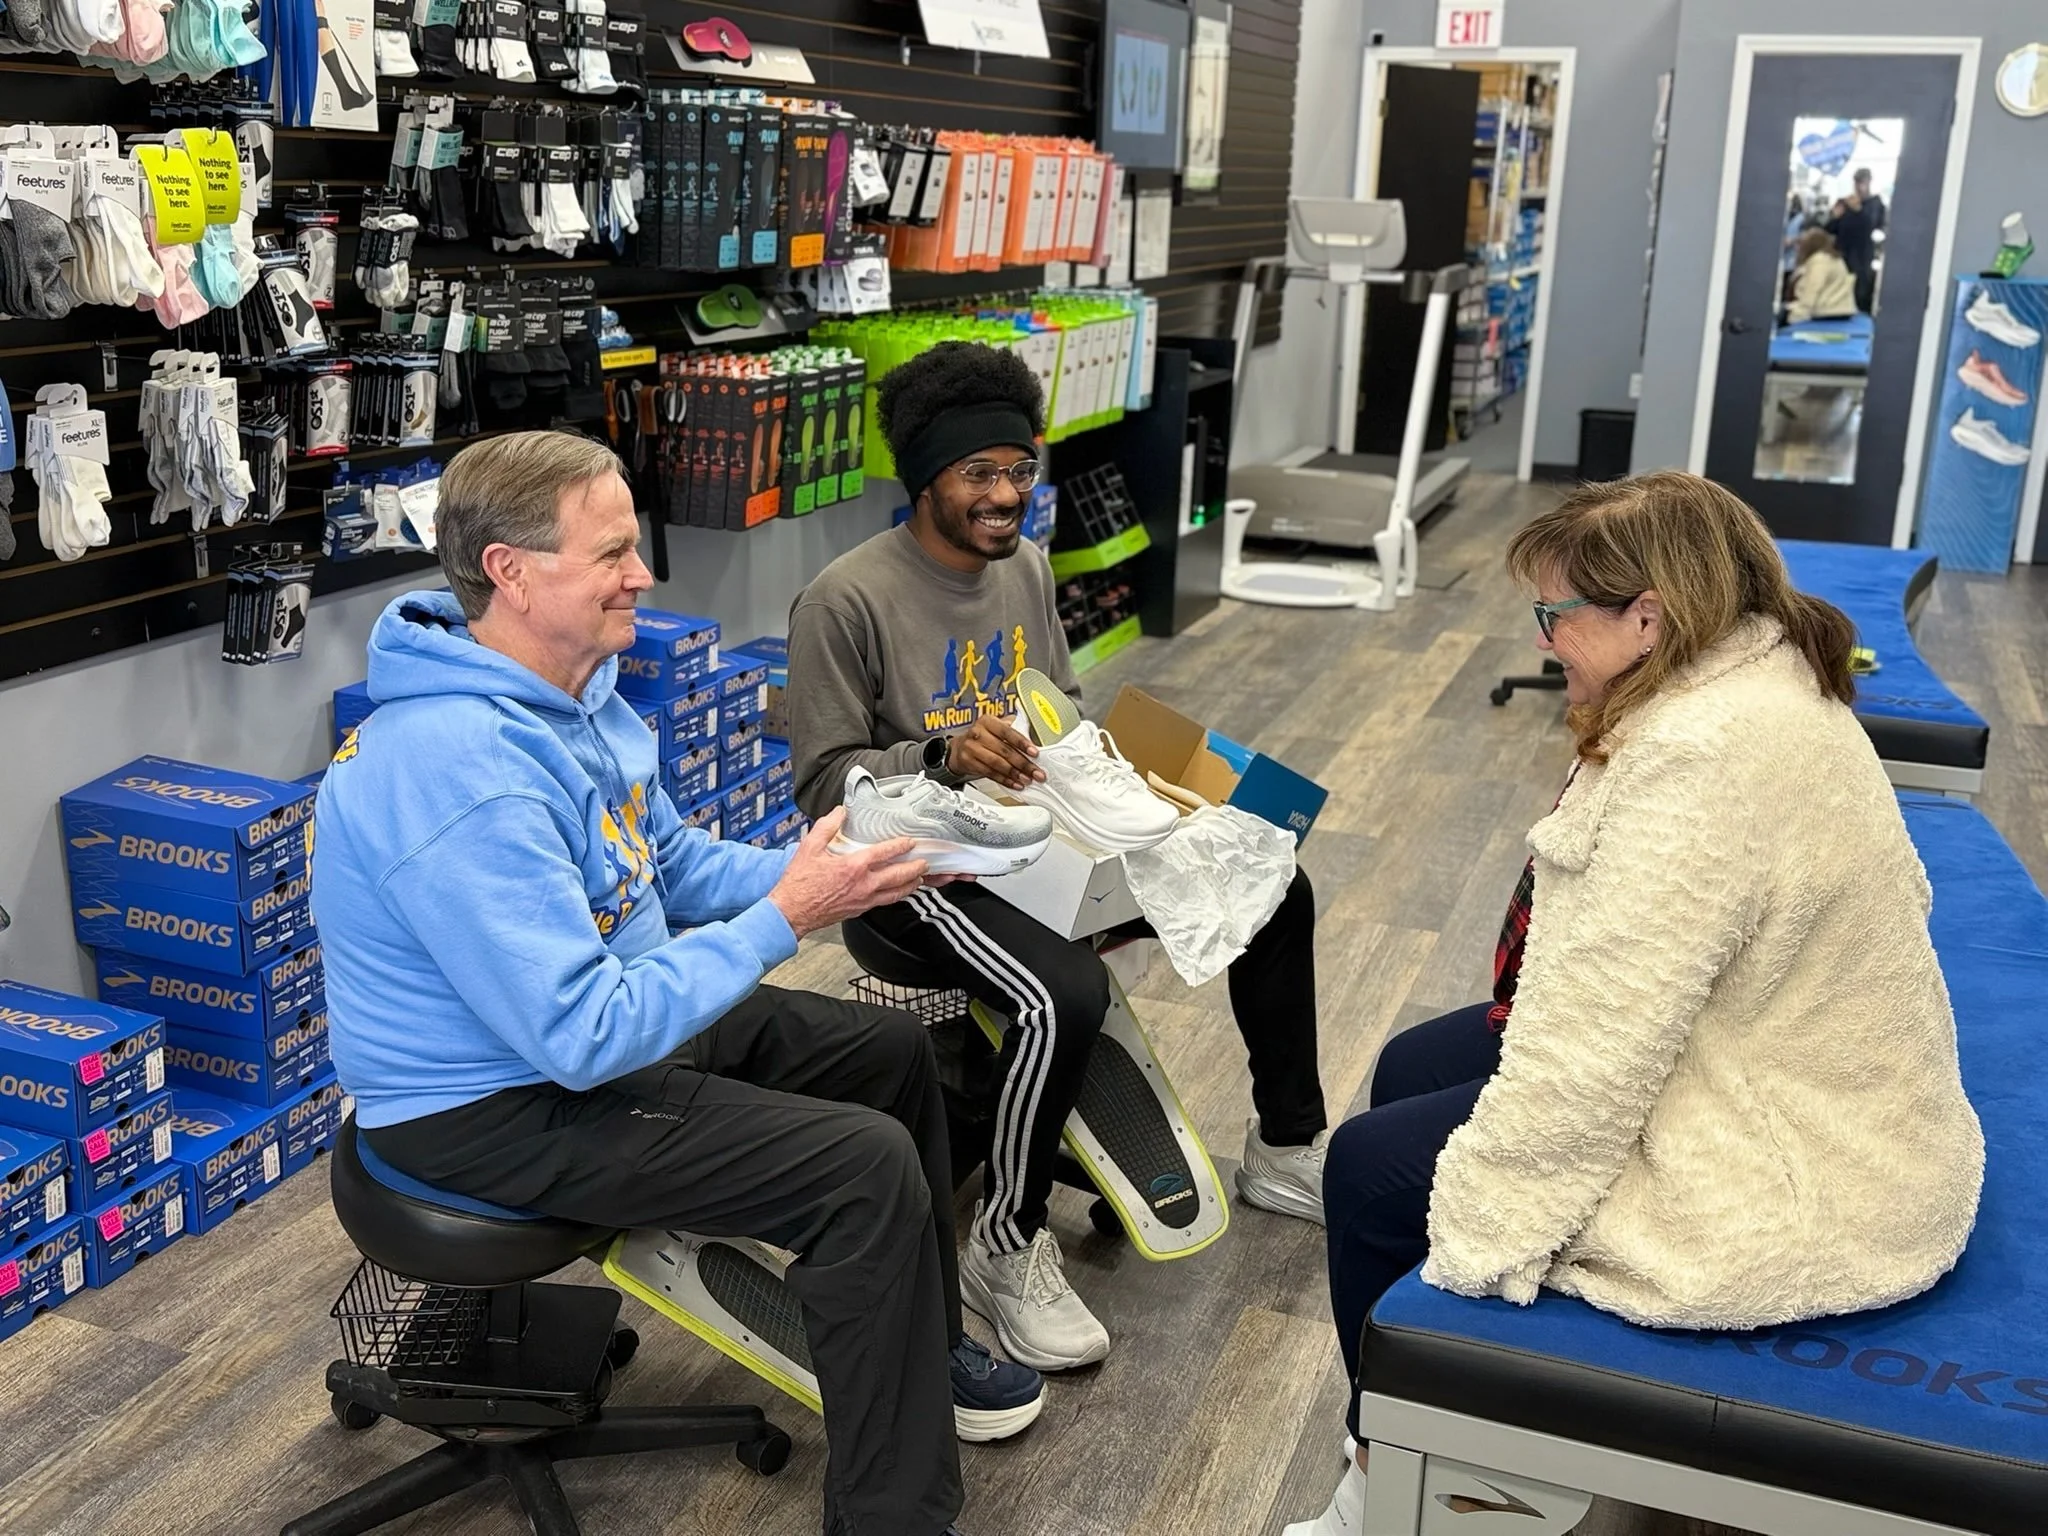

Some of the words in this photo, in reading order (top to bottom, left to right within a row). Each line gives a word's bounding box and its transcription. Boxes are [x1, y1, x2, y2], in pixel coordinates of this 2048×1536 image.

[496, 3, 518, 16] cep
[538, 10, 559, 22] cep
[585, 16, 602, 27] cep
[608, 21, 638, 33] cep
[1449, 11, 1492, 44] EXIT
[198, 158, 232, 170] Nothing
[496, 148, 520, 160] cep
[550, 150, 572, 162] cep
[17, 174, 66, 189] feetures
[102, 172, 134, 186] feetures
[156, 175, 191, 186] Nothing
[205, 170, 214, 180] to
[216, 171, 229, 180] see
[164, 188, 174, 196] to
[208, 181, 228, 191] here.
[169, 199, 190, 208] here.
[310, 389, 323, 430] OS1st
[404, 384, 416, 422] OS1st
[62, 428, 101, 444] feetures
[675, 626, 718, 656] BROOKS
[725, 666, 766, 694] BROOKS
[674, 686, 716, 717] BROOKS
[924, 712, 945, 731] We
[946, 706, 972, 726] Run
[112, 776, 262, 809] BROOKS
[249, 796, 314, 846] BROOKS
[953, 810, 988, 831] BROOKS
[119, 835, 232, 874] BROOKS
[126, 907, 234, 948] BROOKS
[150, 976, 256, 1014] BROOKS
[101, 1024, 160, 1070] ROOKS
[83, 1062, 100, 1074] SALE
[107, 1098, 168, 1146] ROOKS
[89, 1140, 106, 1152] SALE
[206, 1120, 276, 1181] BROOKS
[120, 1173, 180, 1223] ROOKS
[1154, 1188, 1193, 1209] BROOKS
[103, 1217, 120, 1229] SALE
[17, 1225, 80, 1278] ROOKS
